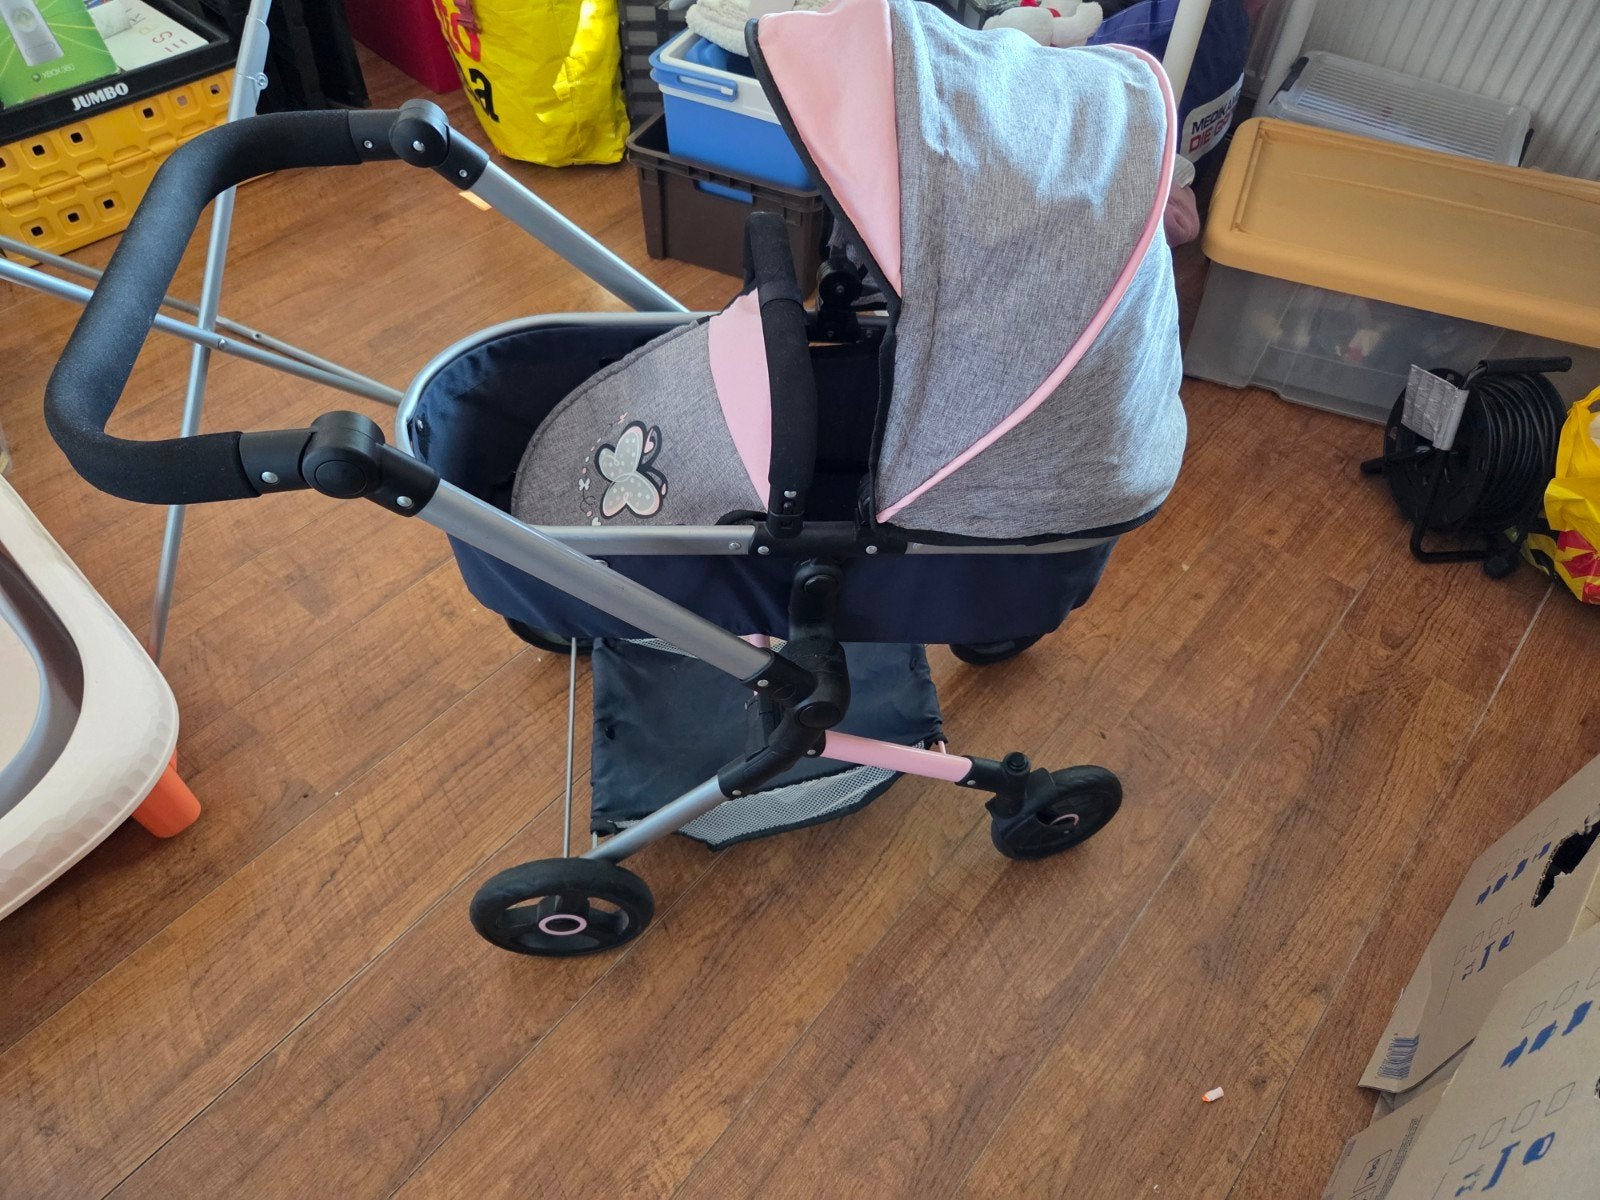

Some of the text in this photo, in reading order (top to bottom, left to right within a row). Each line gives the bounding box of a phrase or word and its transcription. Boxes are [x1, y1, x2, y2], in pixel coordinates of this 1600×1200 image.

[42, 63, 75, 79] XBOX 360
[72, 82, 129, 111] JUMBO
[1189, 126, 1212, 154] DIE
